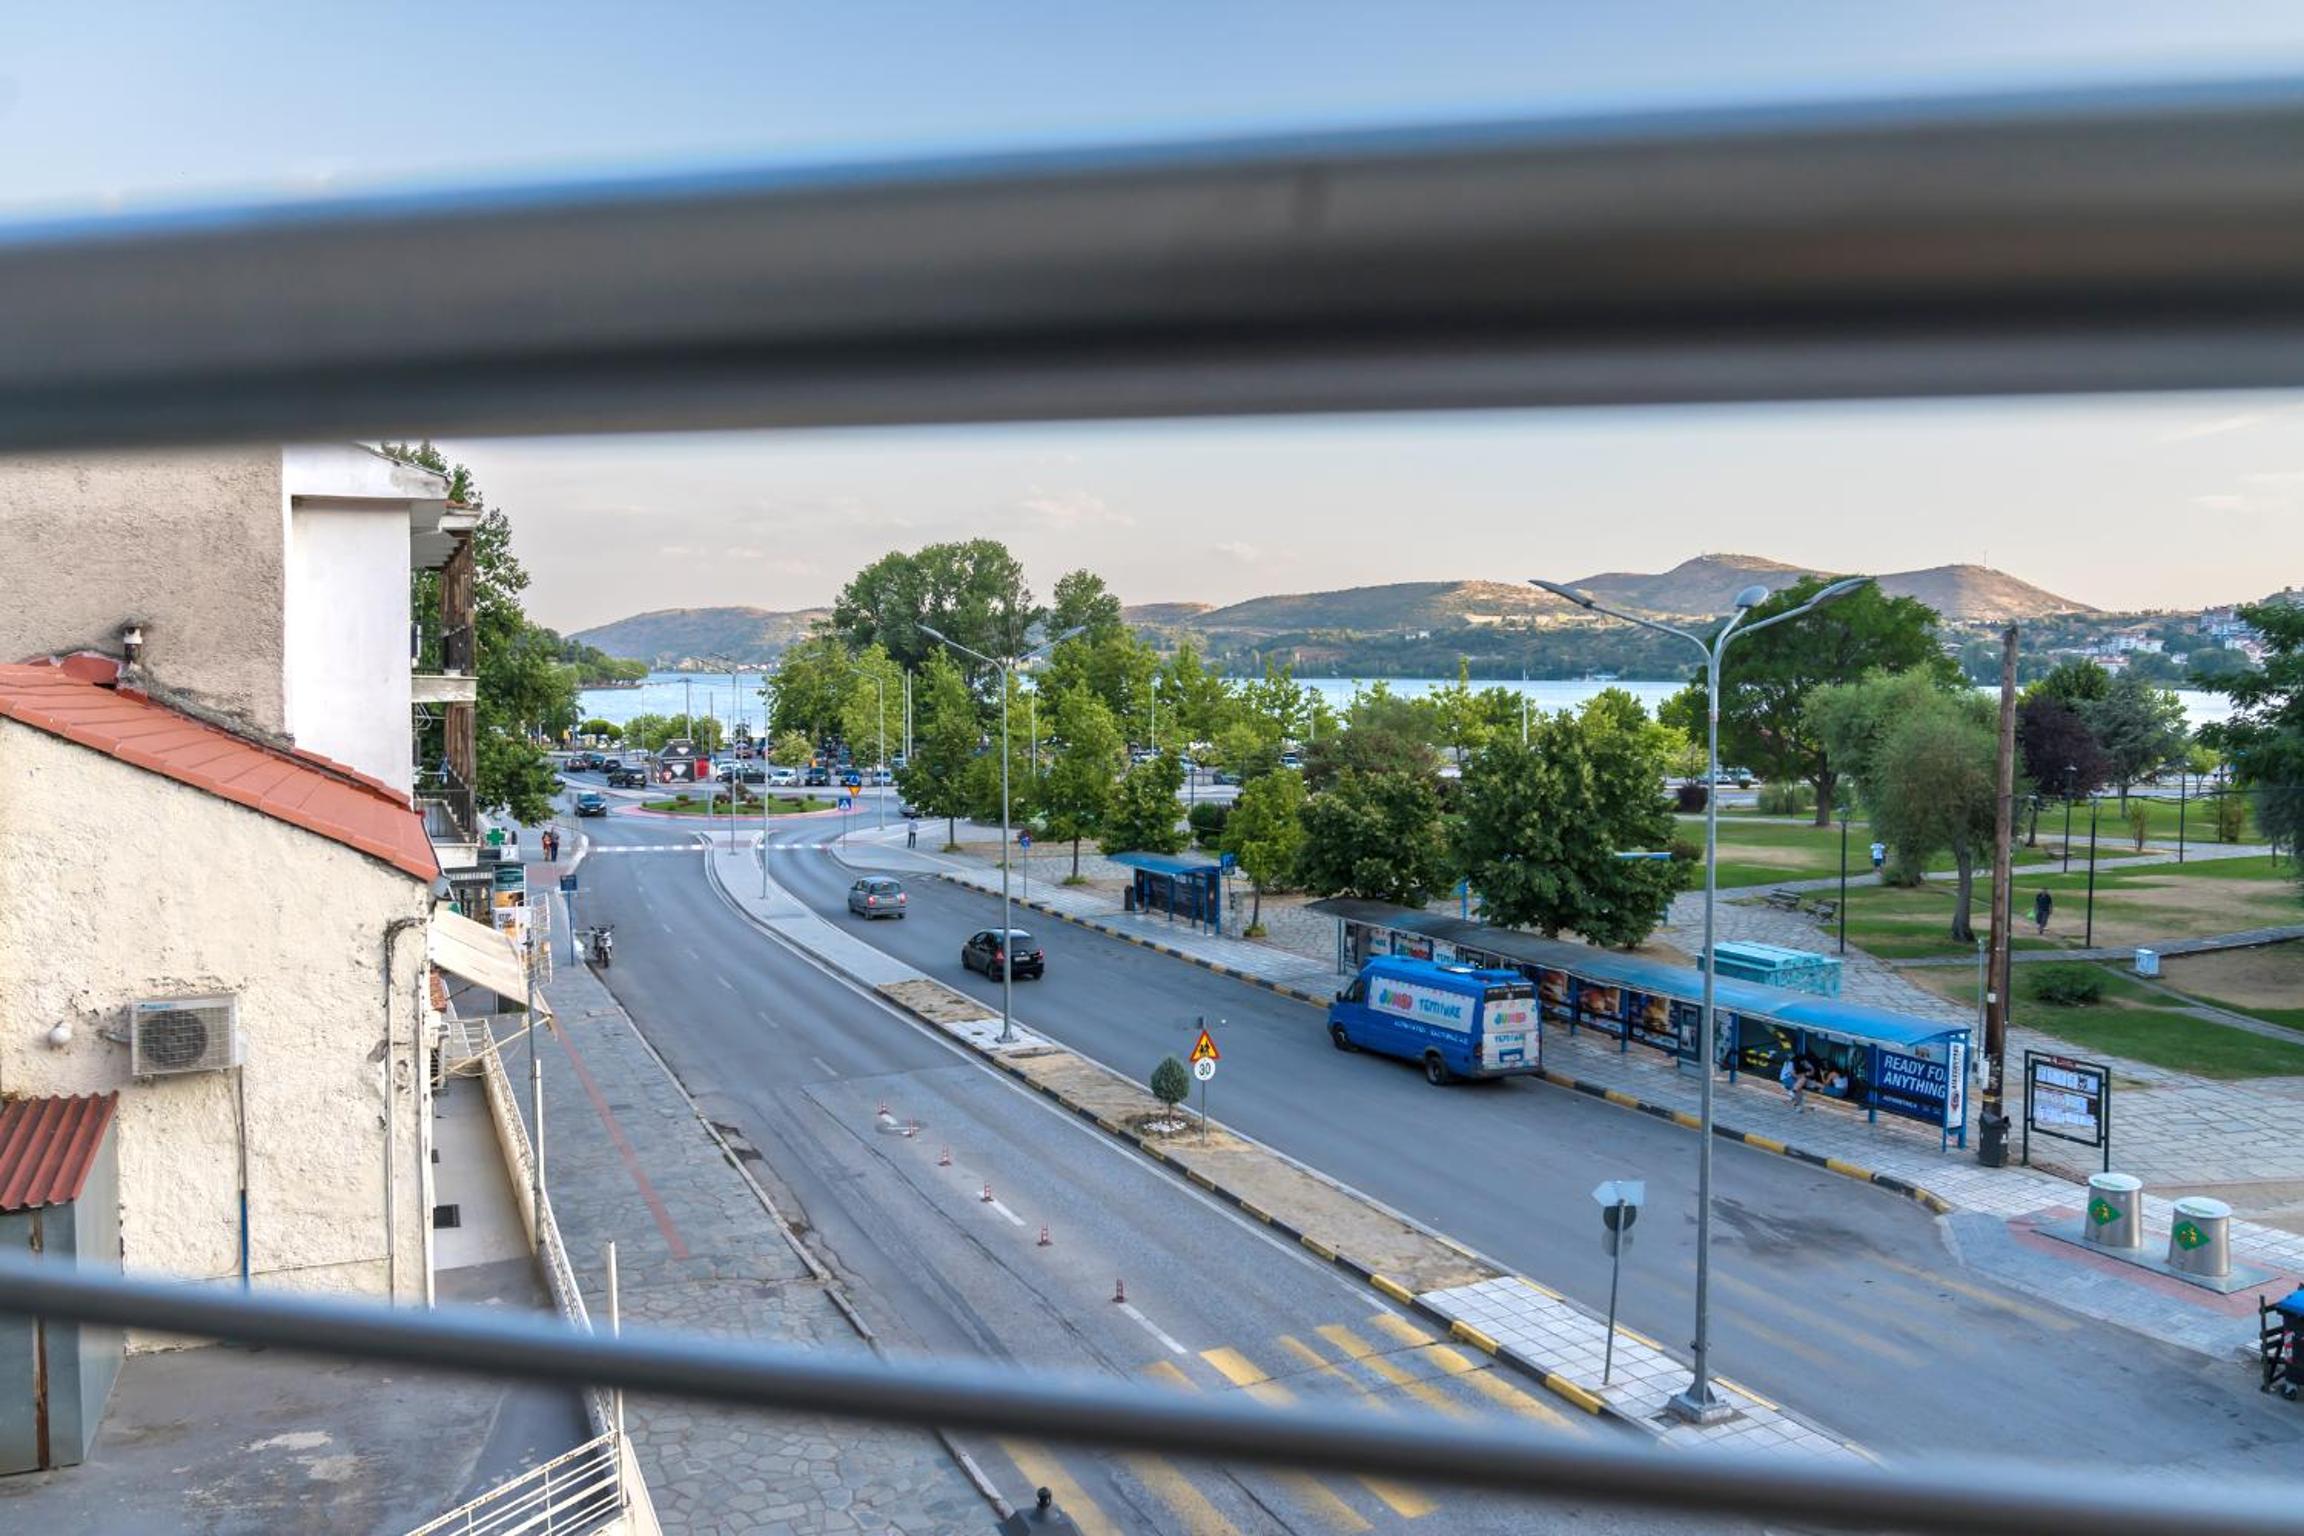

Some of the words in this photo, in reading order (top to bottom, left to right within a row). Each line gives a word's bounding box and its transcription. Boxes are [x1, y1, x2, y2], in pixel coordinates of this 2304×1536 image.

[1199, 1061, 1212, 1076] 30
[1883, 1054, 1925, 1077] READY
[1927, 1065, 1947, 1083] FO
[1882, 1071, 1946, 1099] ANYTHING
